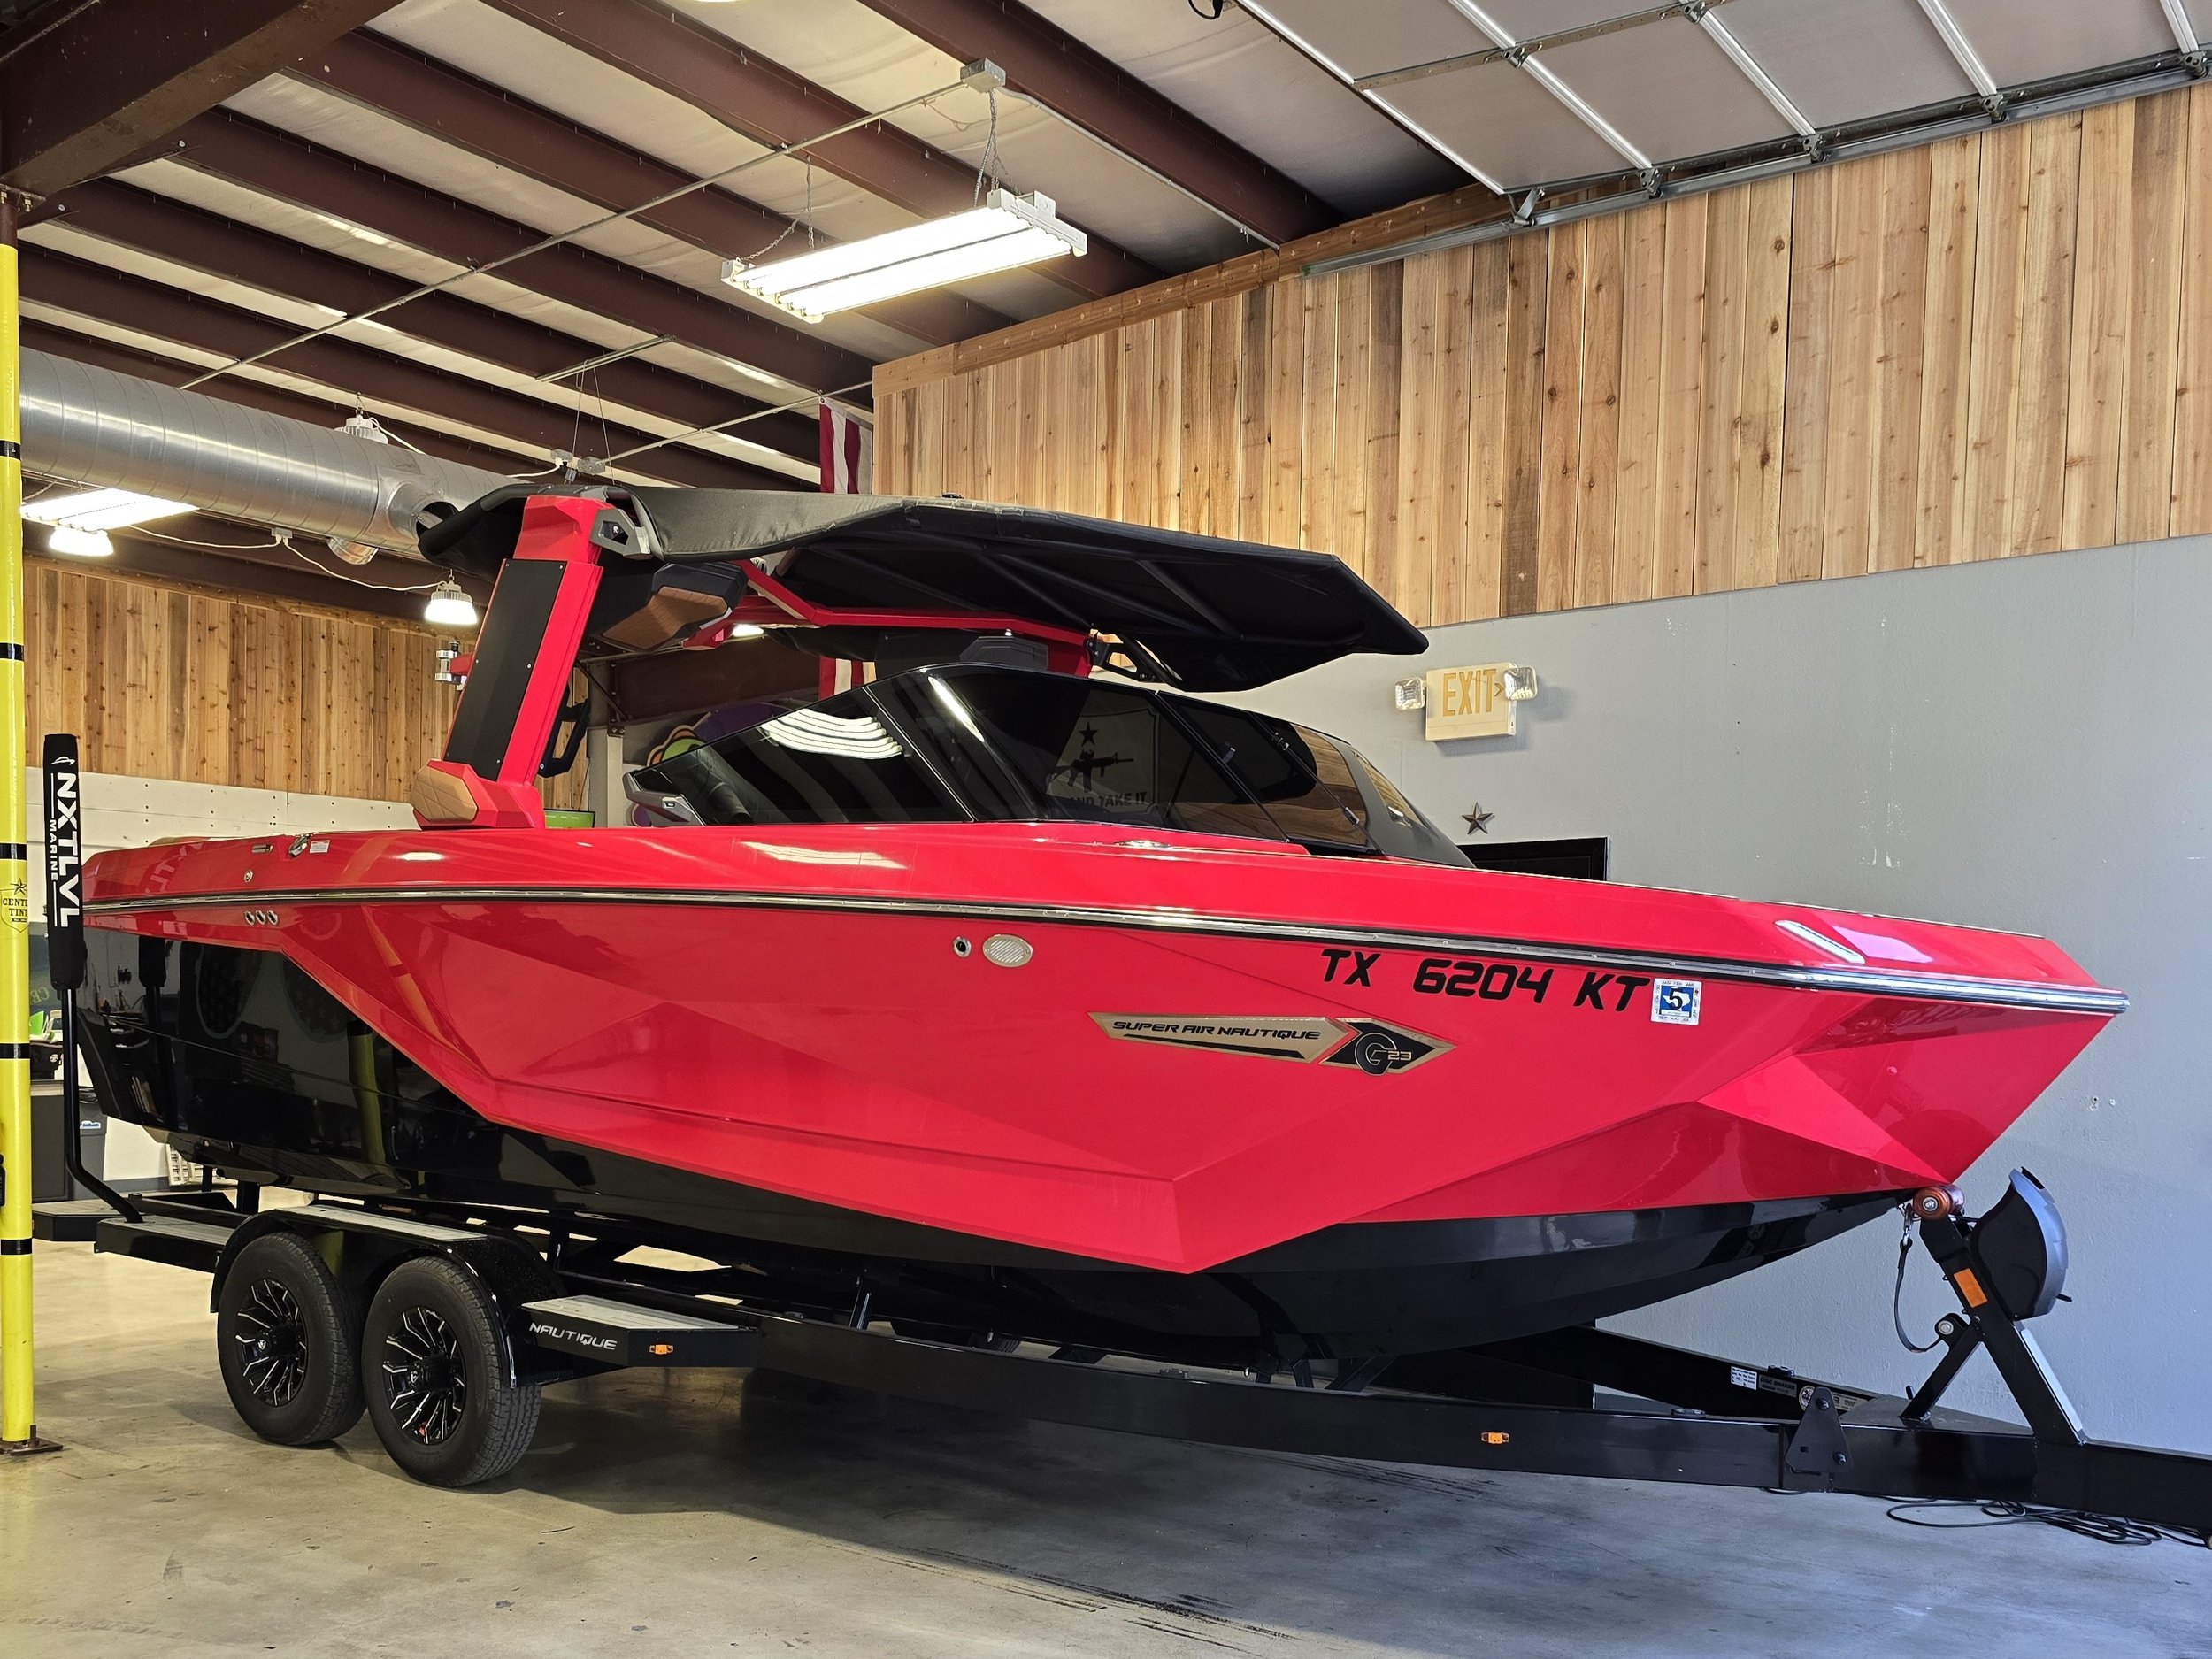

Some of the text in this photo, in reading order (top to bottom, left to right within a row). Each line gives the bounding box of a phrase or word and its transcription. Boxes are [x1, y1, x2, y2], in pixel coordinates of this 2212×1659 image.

[1442, 668, 1496, 717] EXIT
[1099, 793, 1132, 807] TAKE
[1135, 792, 1147, 804] IT
[50, 819, 58, 881] MARINE
[57, 772, 80, 927] NXTLVL
[1321, 949, 1381, 987] TX
[1412, 958, 1555, 1004] 6204
[1572, 972, 1651, 1012] KT
[1669, 987, 1684, 1011] 5
[1112, 1021, 1322, 1040] SUPER AIR NAUTIQUE
[529, 1322, 618, 1350] NAUTIQUE
